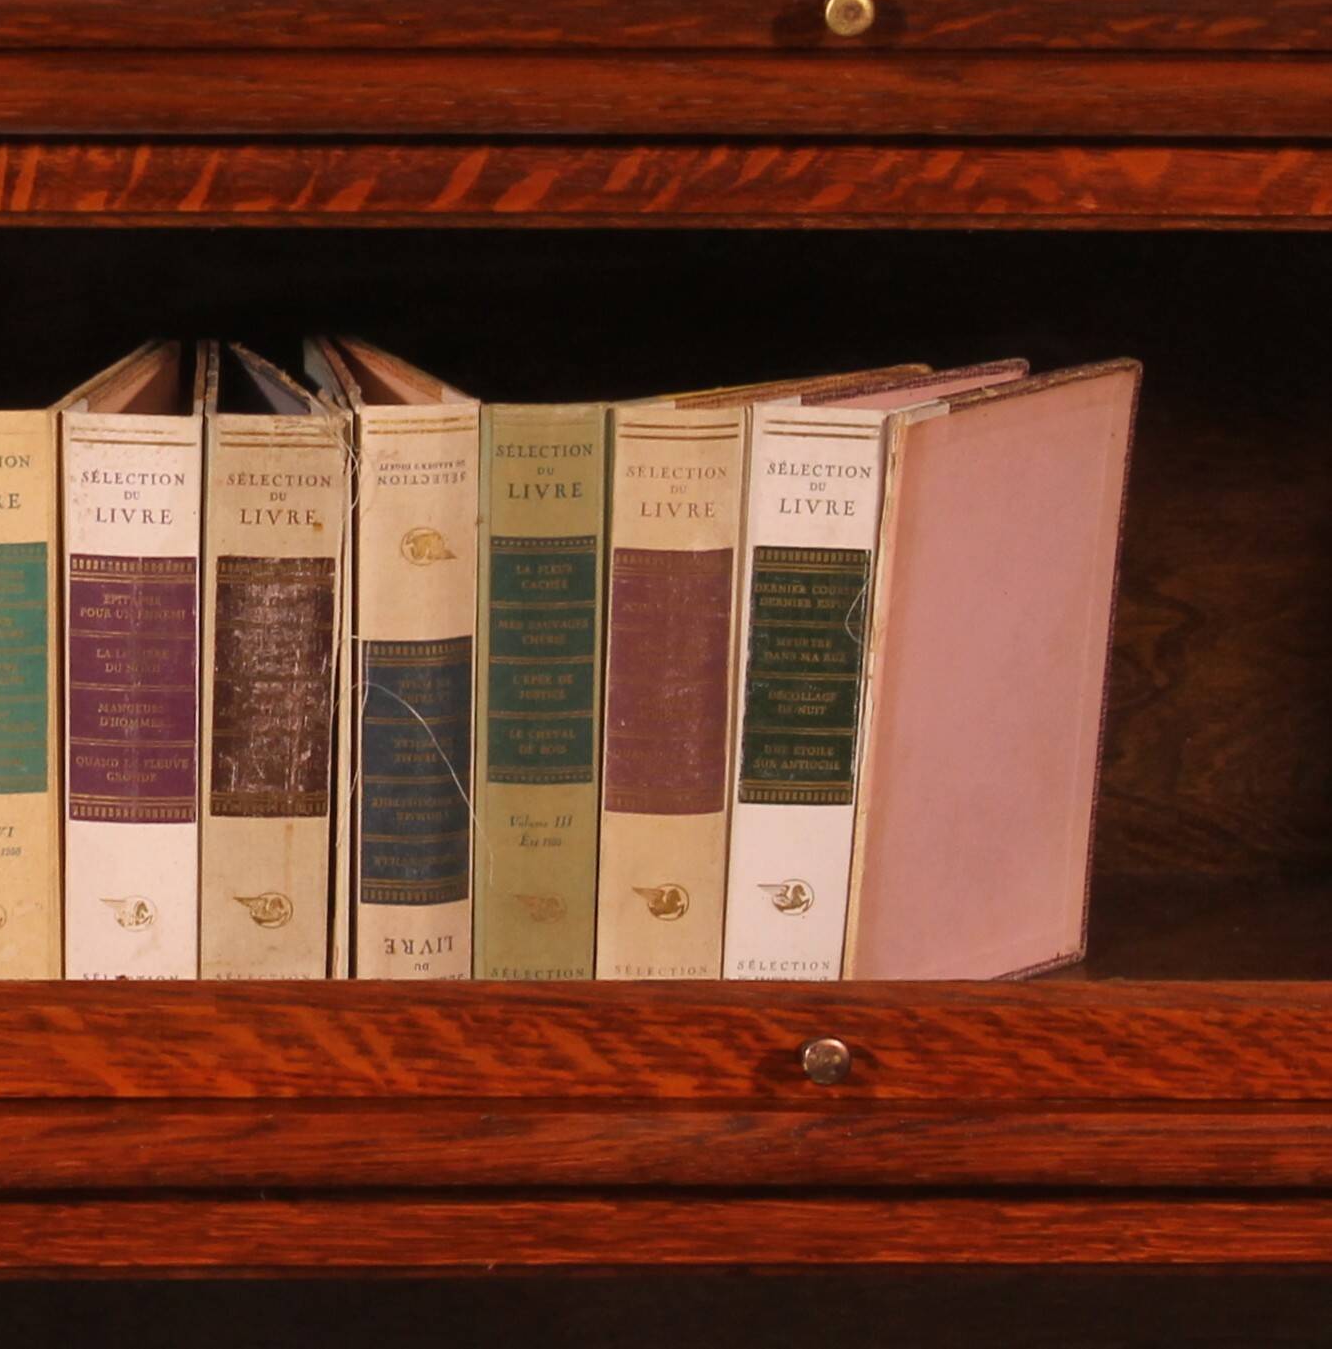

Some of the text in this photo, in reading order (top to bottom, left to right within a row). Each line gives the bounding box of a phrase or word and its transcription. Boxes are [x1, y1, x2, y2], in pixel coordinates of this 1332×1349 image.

[496, 441, 594, 460] SÉLECTION
[537, 466, 555, 476] DU
[768, 461, 872, 480] SÉLECTION
[82, 468, 186, 488] SÉLECTION
[226, 472, 332, 489] SÉLECTION
[378, 470, 467, 487] SÉLECTION
[508, 481, 583, 500] LIVRE
[809, 483, 826, 493] DU
[124, 491, 141, 501] DU
[269, 492, 287, 503] DU
[640, 500, 716, 518] LIVRE
[779, 497, 856, 516] LIVRE
[95, 507, 174, 526] LIVRE
[239, 509, 321, 526] LIVRE
[80, 607, 112, 620] POUR
[97, 648, 111, 659] LA
[802, 652, 820, 664] MA
[105, 662, 122, 674] DU
[798, 705, 827, 718] NUIT
[75, 755, 120, 768] QUAND
[753, 758, 841, 772] SUR ANTIOCHE
[384, 934, 454, 956] LIVRE
[414, 961, 430, 972] DU
[737, 958, 831, 972] SÉLECTION
